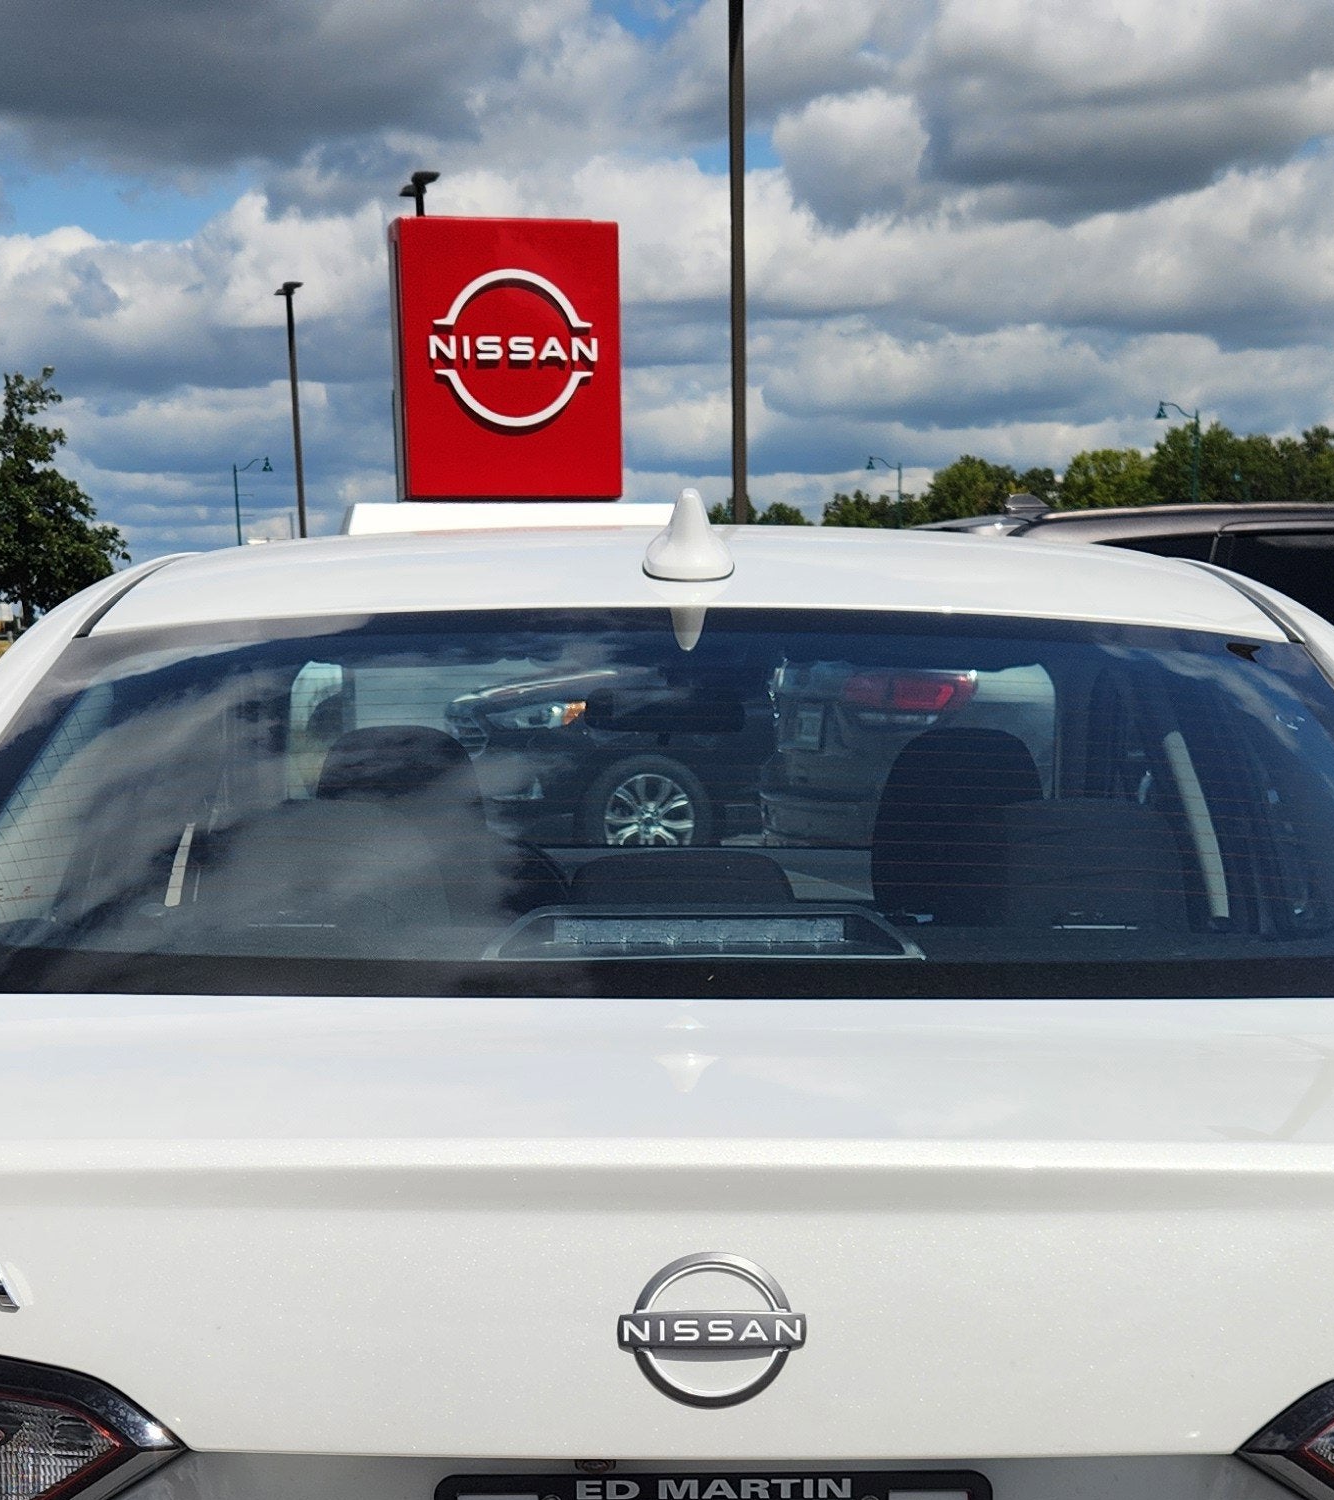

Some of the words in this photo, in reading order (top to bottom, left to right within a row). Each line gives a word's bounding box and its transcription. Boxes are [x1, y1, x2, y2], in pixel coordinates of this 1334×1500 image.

[428, 335, 598, 361] NISSAN
[623, 1319, 802, 1342] NISSAN
[576, 1480, 640, 1500] ED
[658, 1478, 852, 1500] MARTIN
